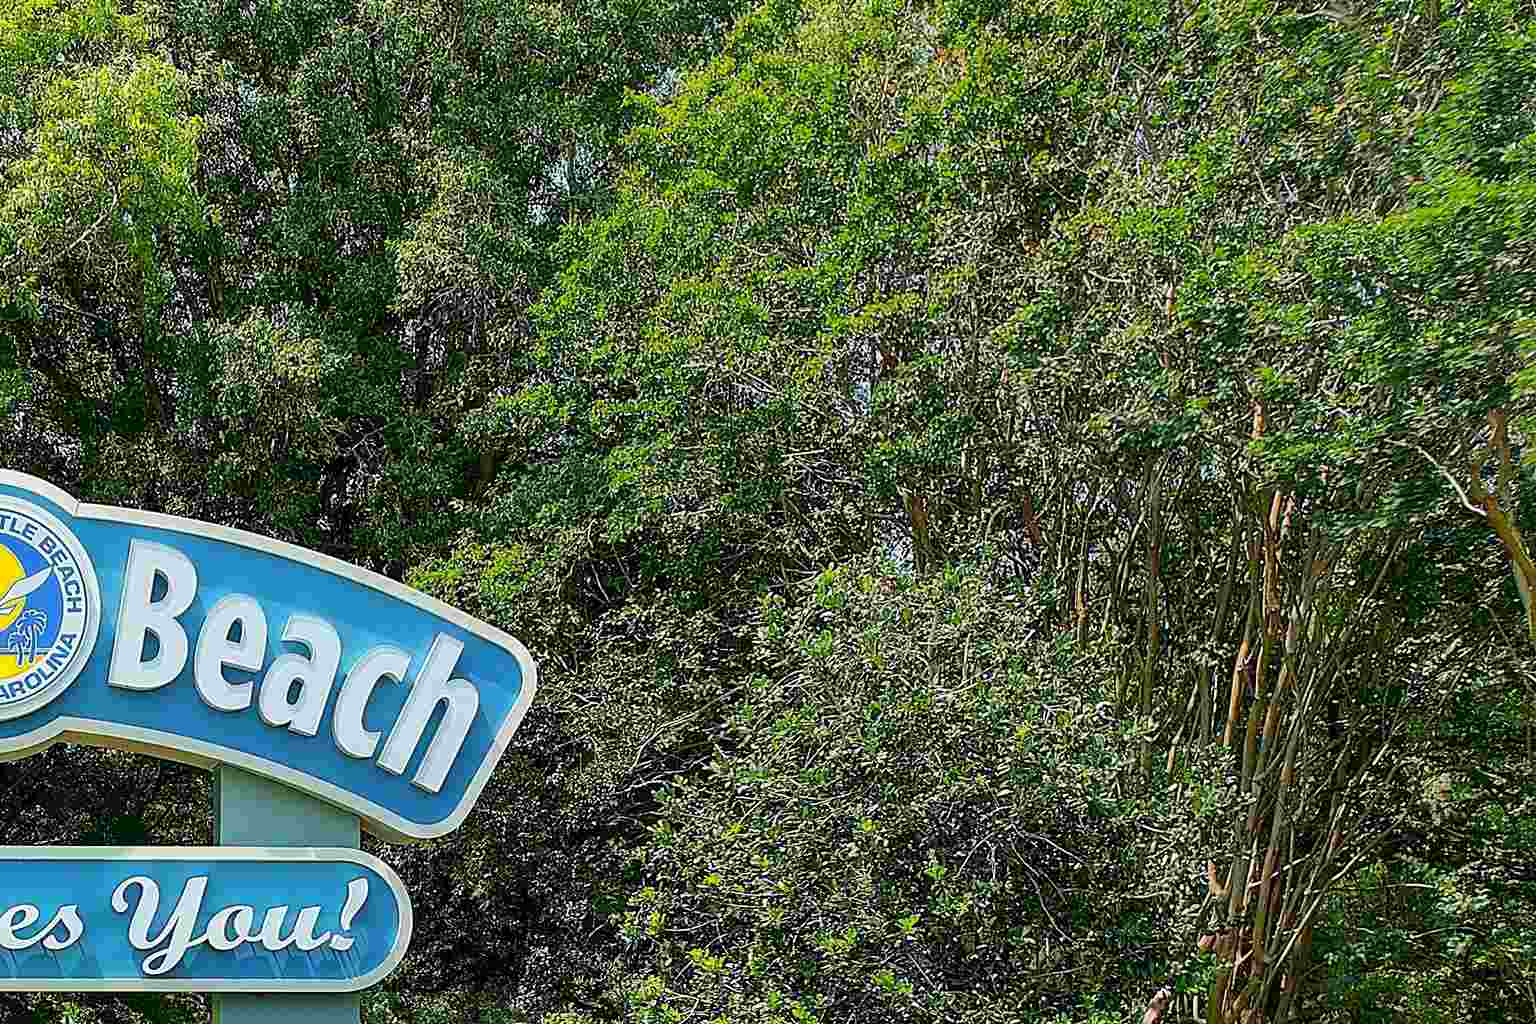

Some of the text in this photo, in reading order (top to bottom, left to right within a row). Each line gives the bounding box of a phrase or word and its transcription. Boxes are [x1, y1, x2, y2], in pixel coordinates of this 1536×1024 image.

[39, 536, 82, 612] BEACH
[108, 539, 480, 794] Beach
[111, 875, 370, 977] You!
